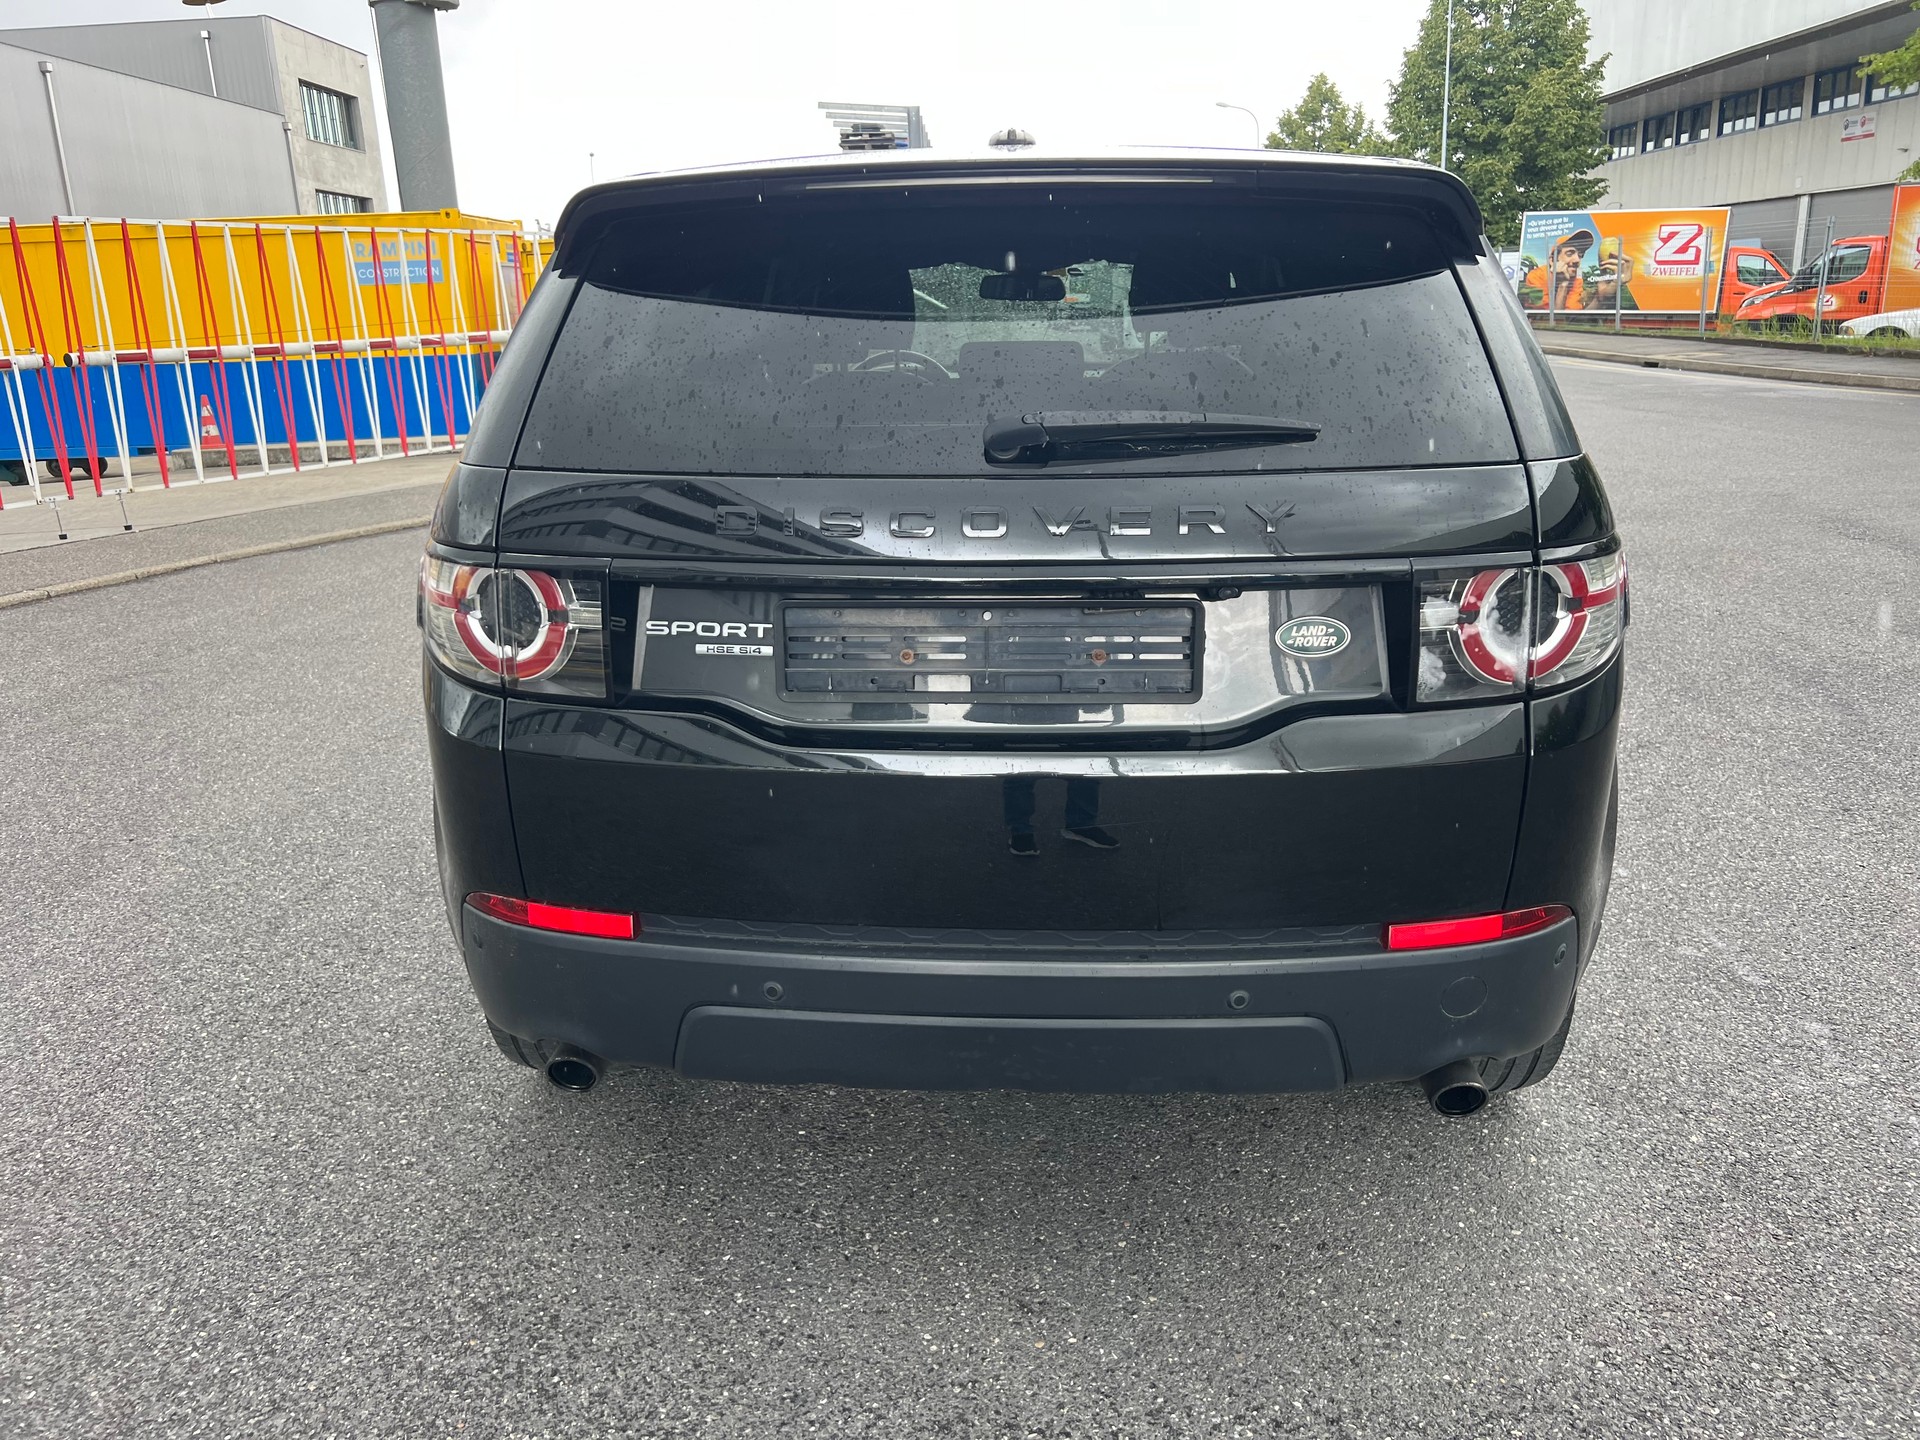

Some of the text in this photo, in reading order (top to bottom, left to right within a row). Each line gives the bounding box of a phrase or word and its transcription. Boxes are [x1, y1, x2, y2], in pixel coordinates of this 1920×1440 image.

[354, 240, 437, 257] RMINI
[1654, 224, 1704, 265] Z
[358, 266, 440, 278] COSTRCTIN
[1652, 267, 1698, 276] ZWEIFEL
[715, 502, 1296, 539] DISCOVERY
[645, 620, 773, 639] SPORT
[706, 645, 735, 654] HSE
